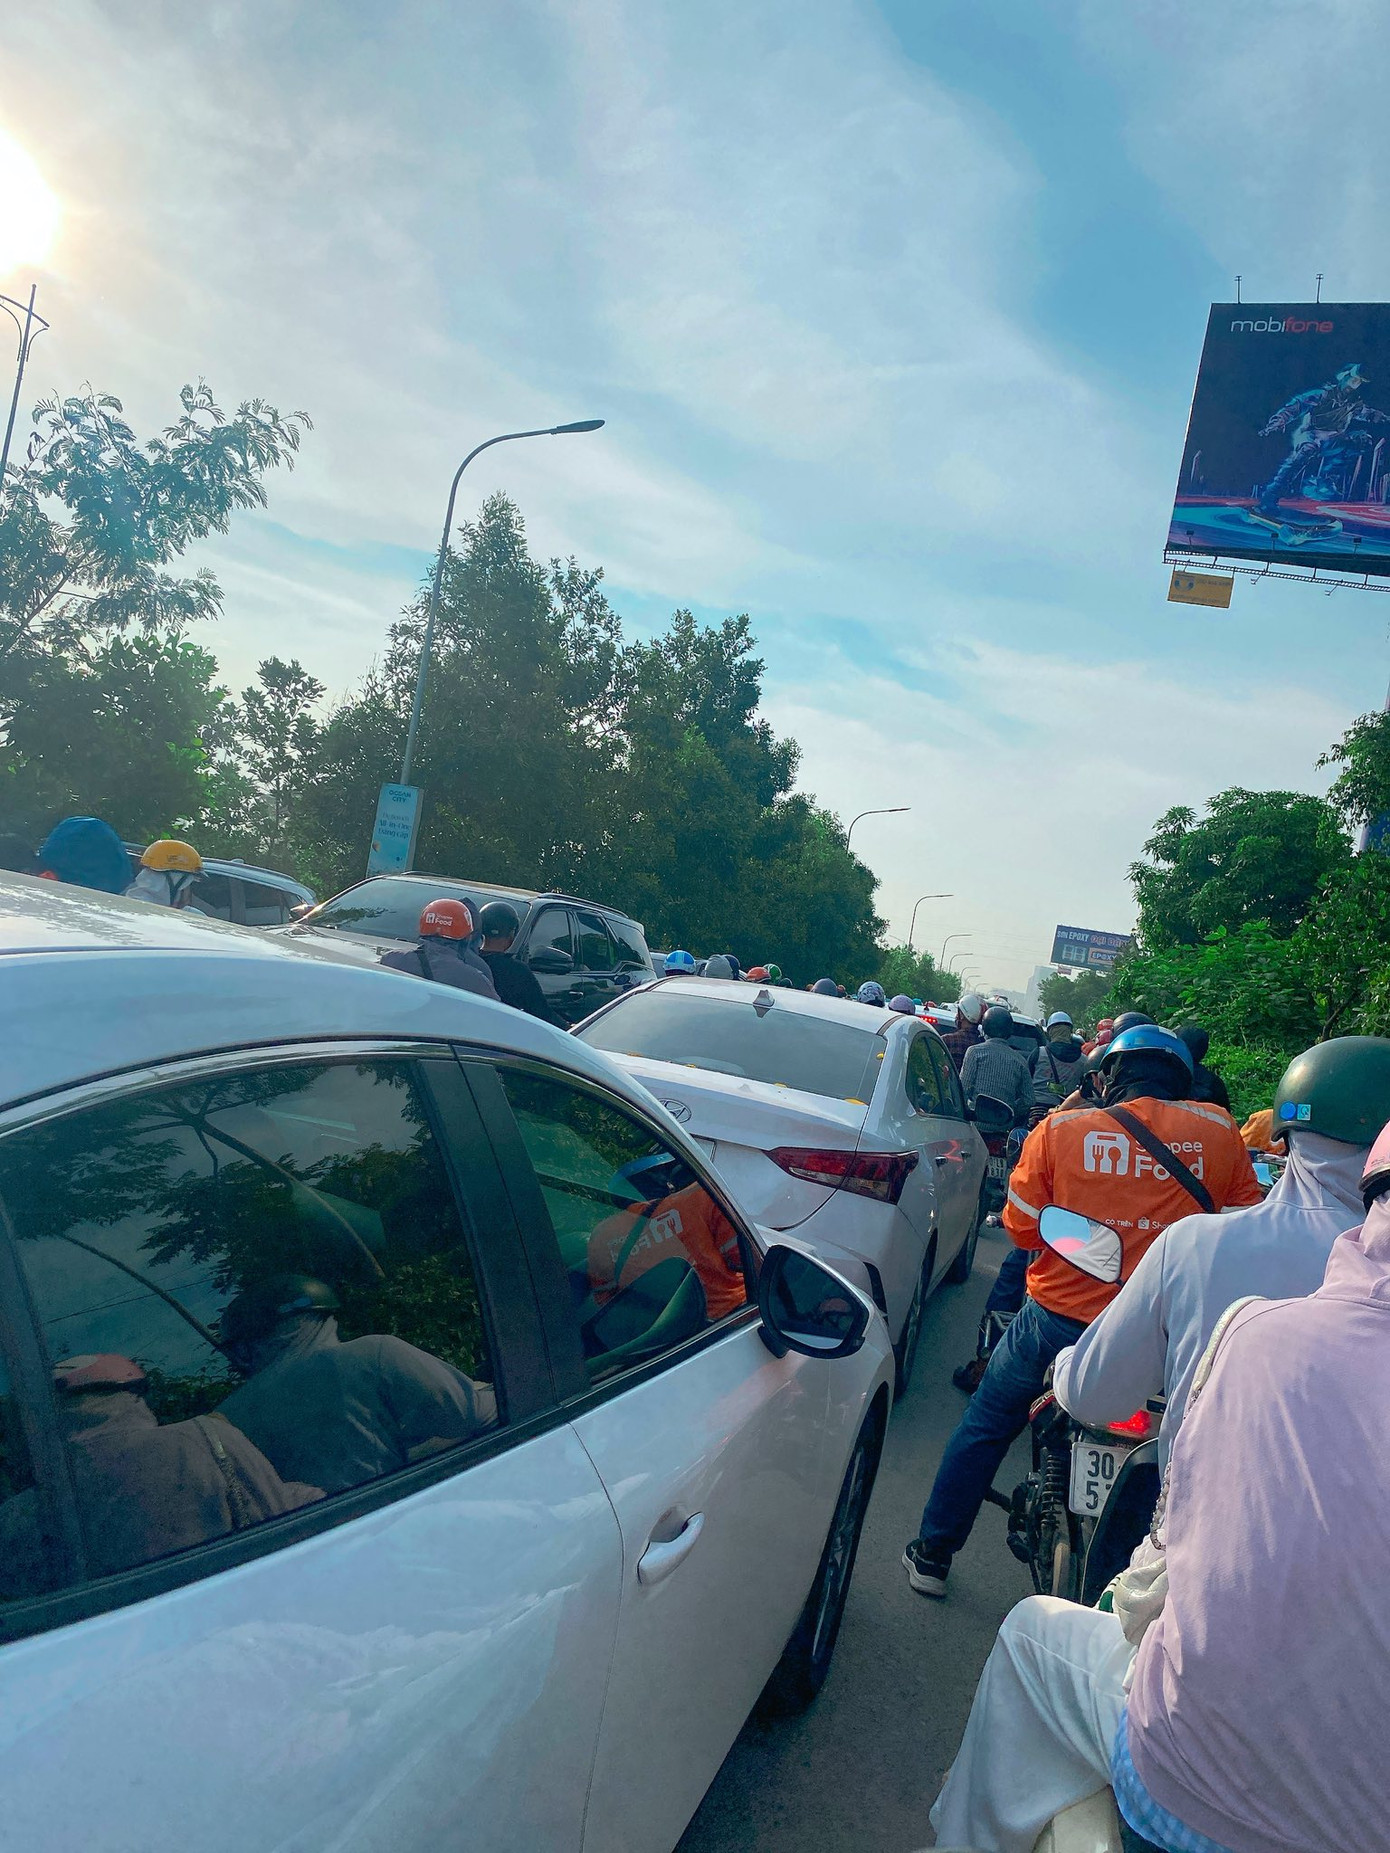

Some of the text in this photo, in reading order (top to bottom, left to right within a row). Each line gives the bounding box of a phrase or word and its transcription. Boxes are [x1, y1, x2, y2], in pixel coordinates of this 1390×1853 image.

[1230, 316, 1333, 332] mobifone
[434, 917, 453, 926] Food
[1069, 931, 1090, 942] EPOXY
[1092, 952, 1117, 961] EPOXY
[1134, 1154, 1204, 1181] Fod
[1152, 1221, 1168, 1230] Sho
[1087, 1450, 1116, 1480] 30
